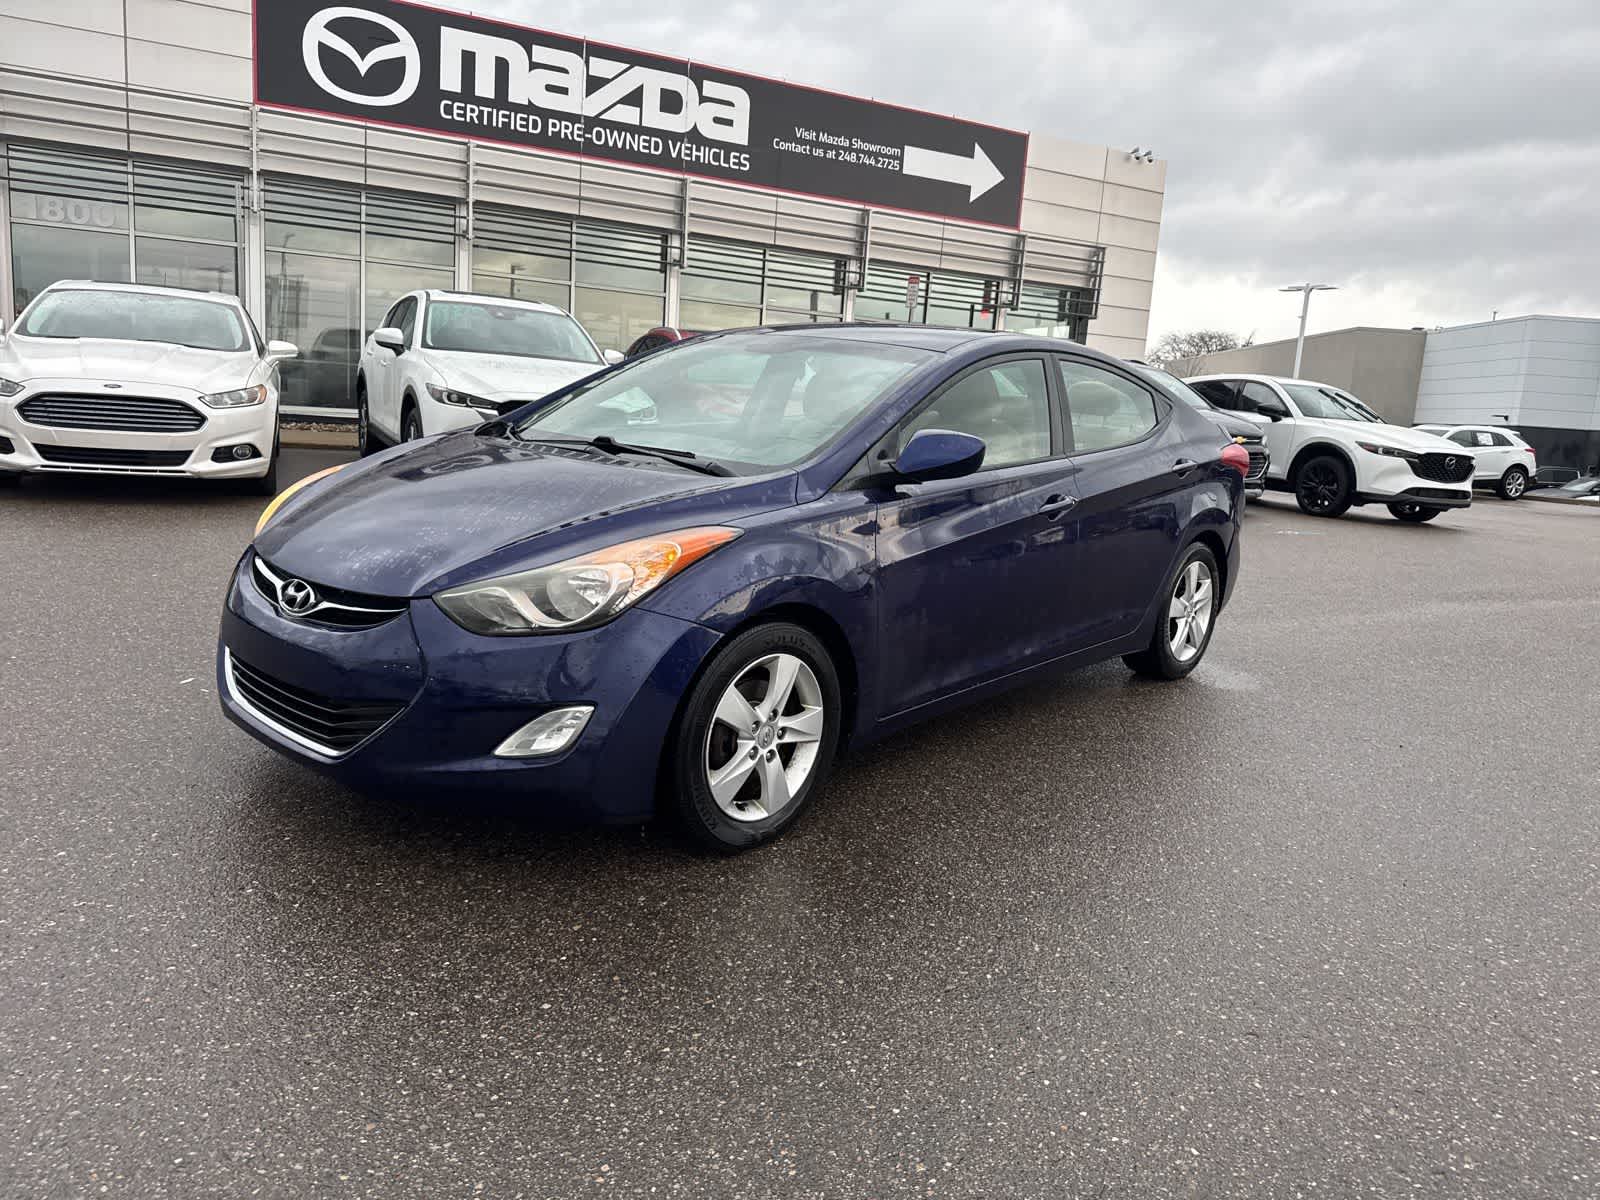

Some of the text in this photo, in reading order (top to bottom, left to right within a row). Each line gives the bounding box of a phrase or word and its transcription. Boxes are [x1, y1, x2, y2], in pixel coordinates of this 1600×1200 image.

[439, 26, 751, 146] mazda
[439, 99, 751, 171] CERTIFIED PRE-OWNED VEHICLES
[773, 137, 900, 171] Contact us at 248.744.2725
[795, 126, 901, 157] Visit Mazda Showroom
